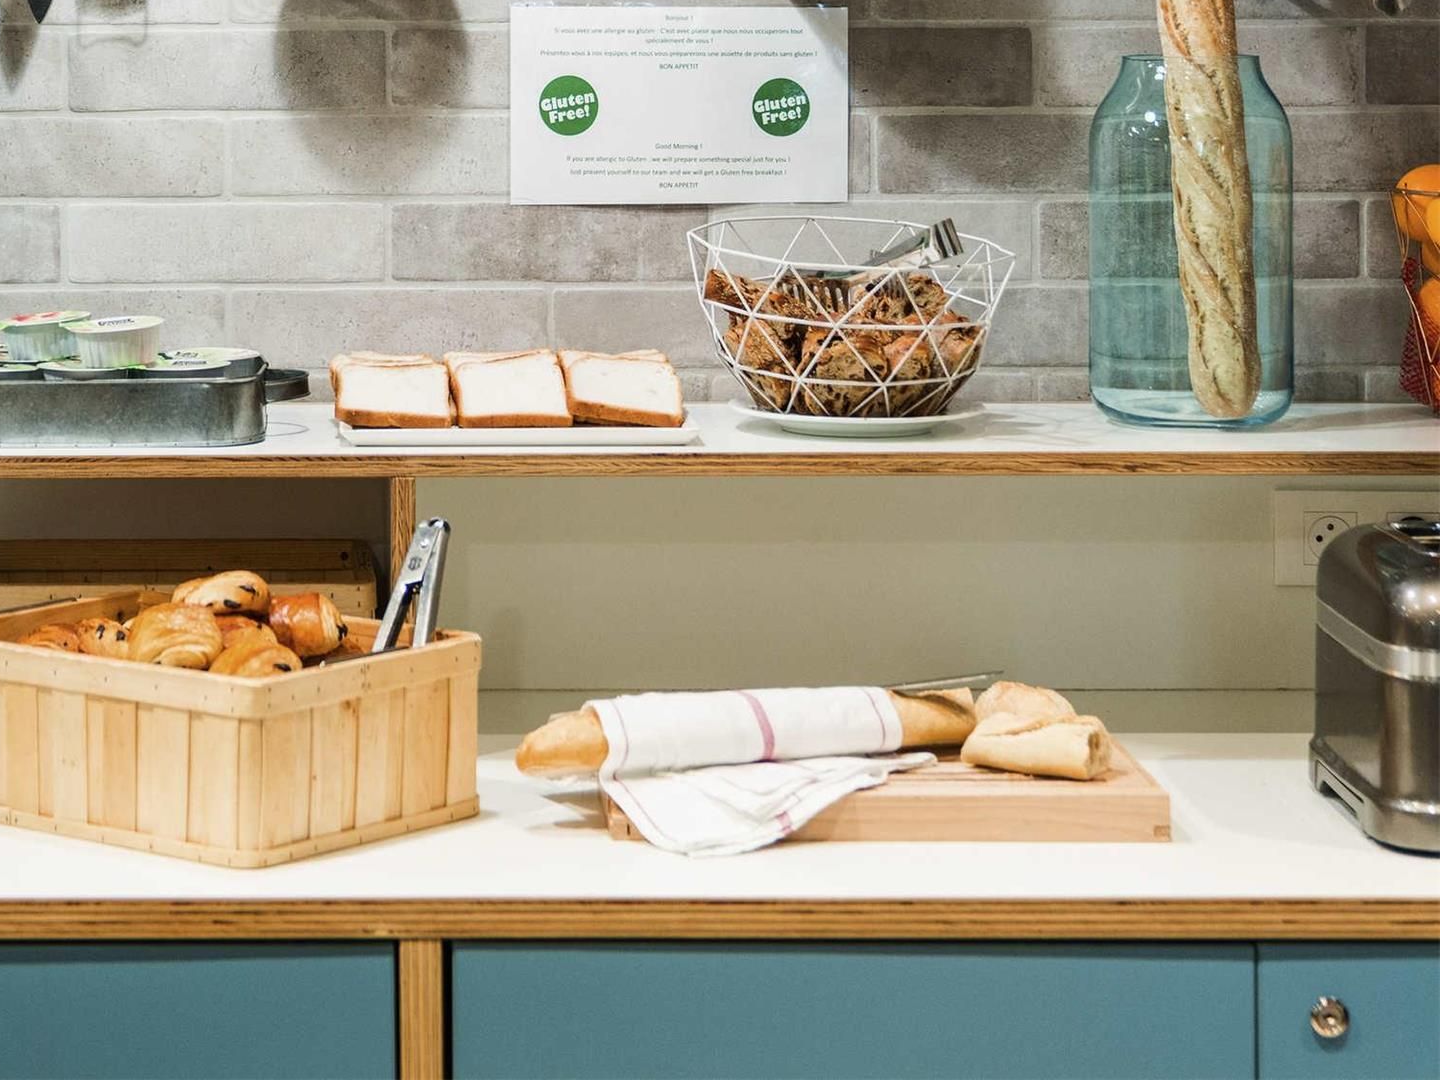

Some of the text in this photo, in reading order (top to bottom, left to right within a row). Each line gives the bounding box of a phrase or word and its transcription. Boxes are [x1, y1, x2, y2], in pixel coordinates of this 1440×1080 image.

[540, 92, 596, 112] Gluten
[753, 95, 807, 113] Gluten
[548, 104, 590, 124] Free!
[761, 106, 802, 126] Free!
